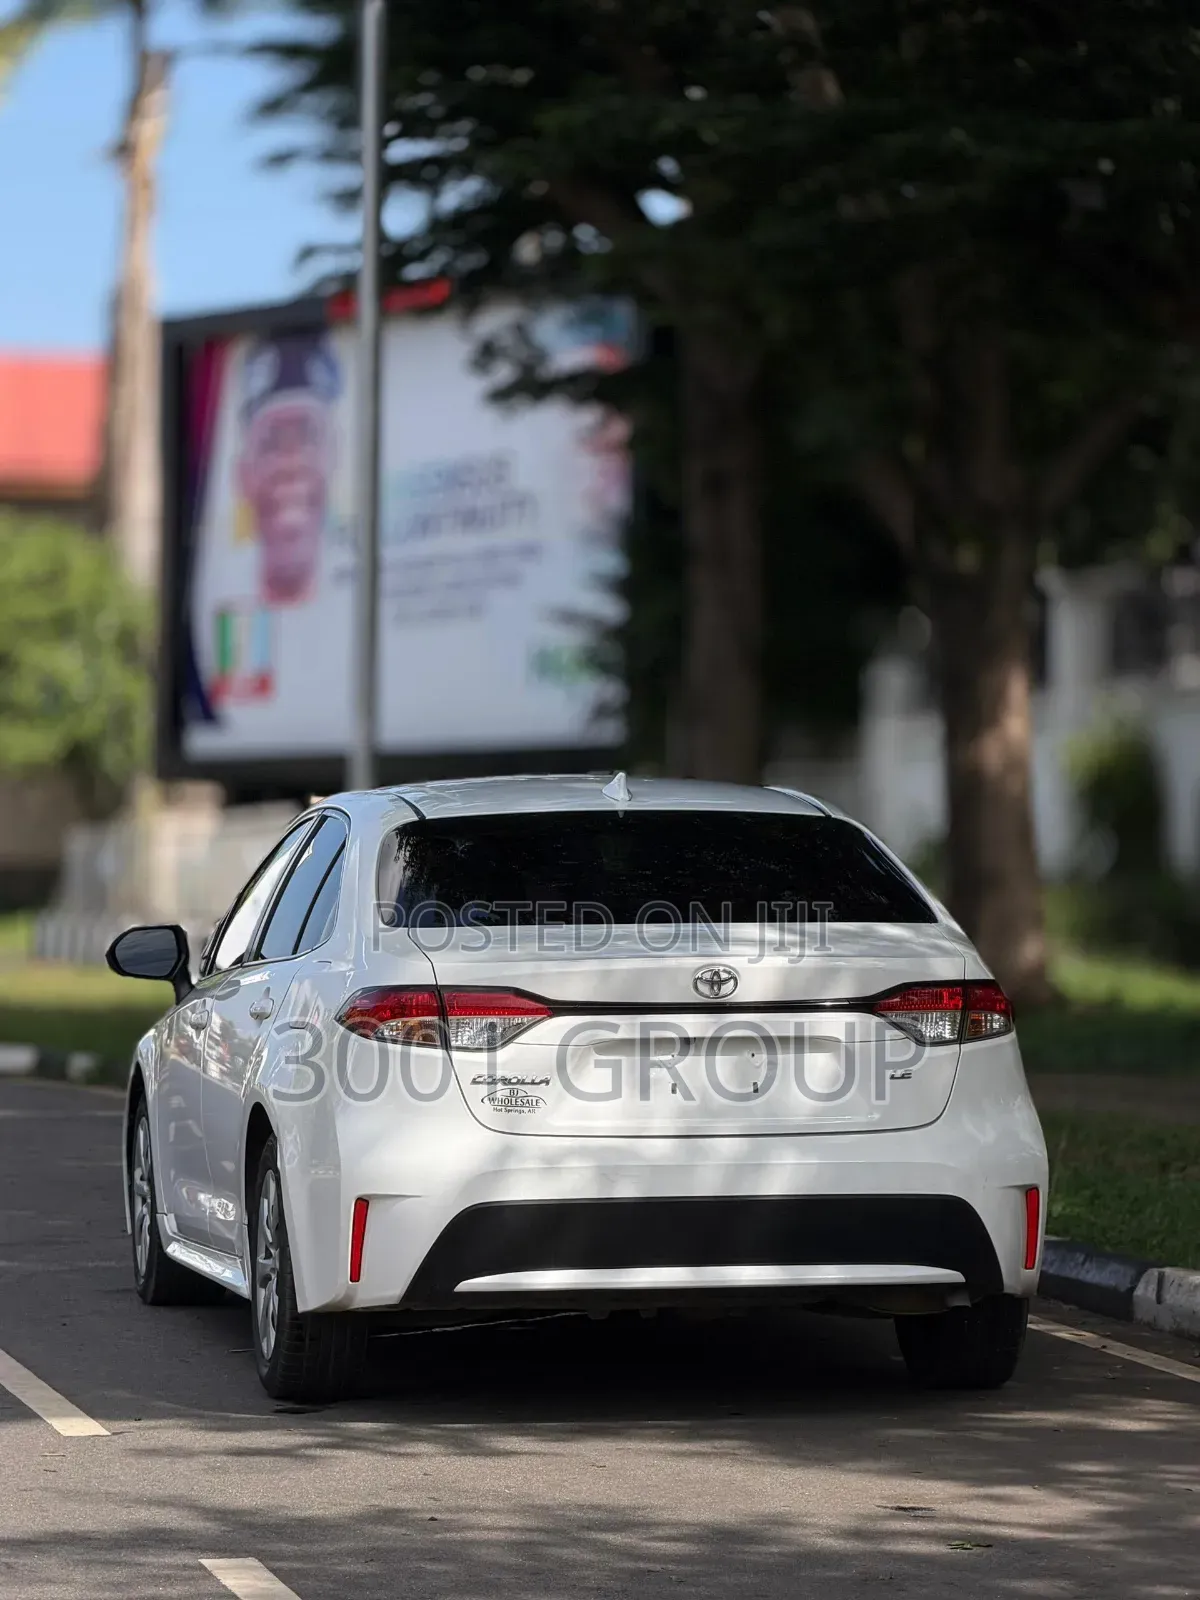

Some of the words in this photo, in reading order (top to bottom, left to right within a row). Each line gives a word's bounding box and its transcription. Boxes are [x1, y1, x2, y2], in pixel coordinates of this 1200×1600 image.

[470, 1074, 551, 1086] COROLLA
[889, 1069, 912, 1080] LE
[488, 1097, 541, 1107] WHOLESALE
